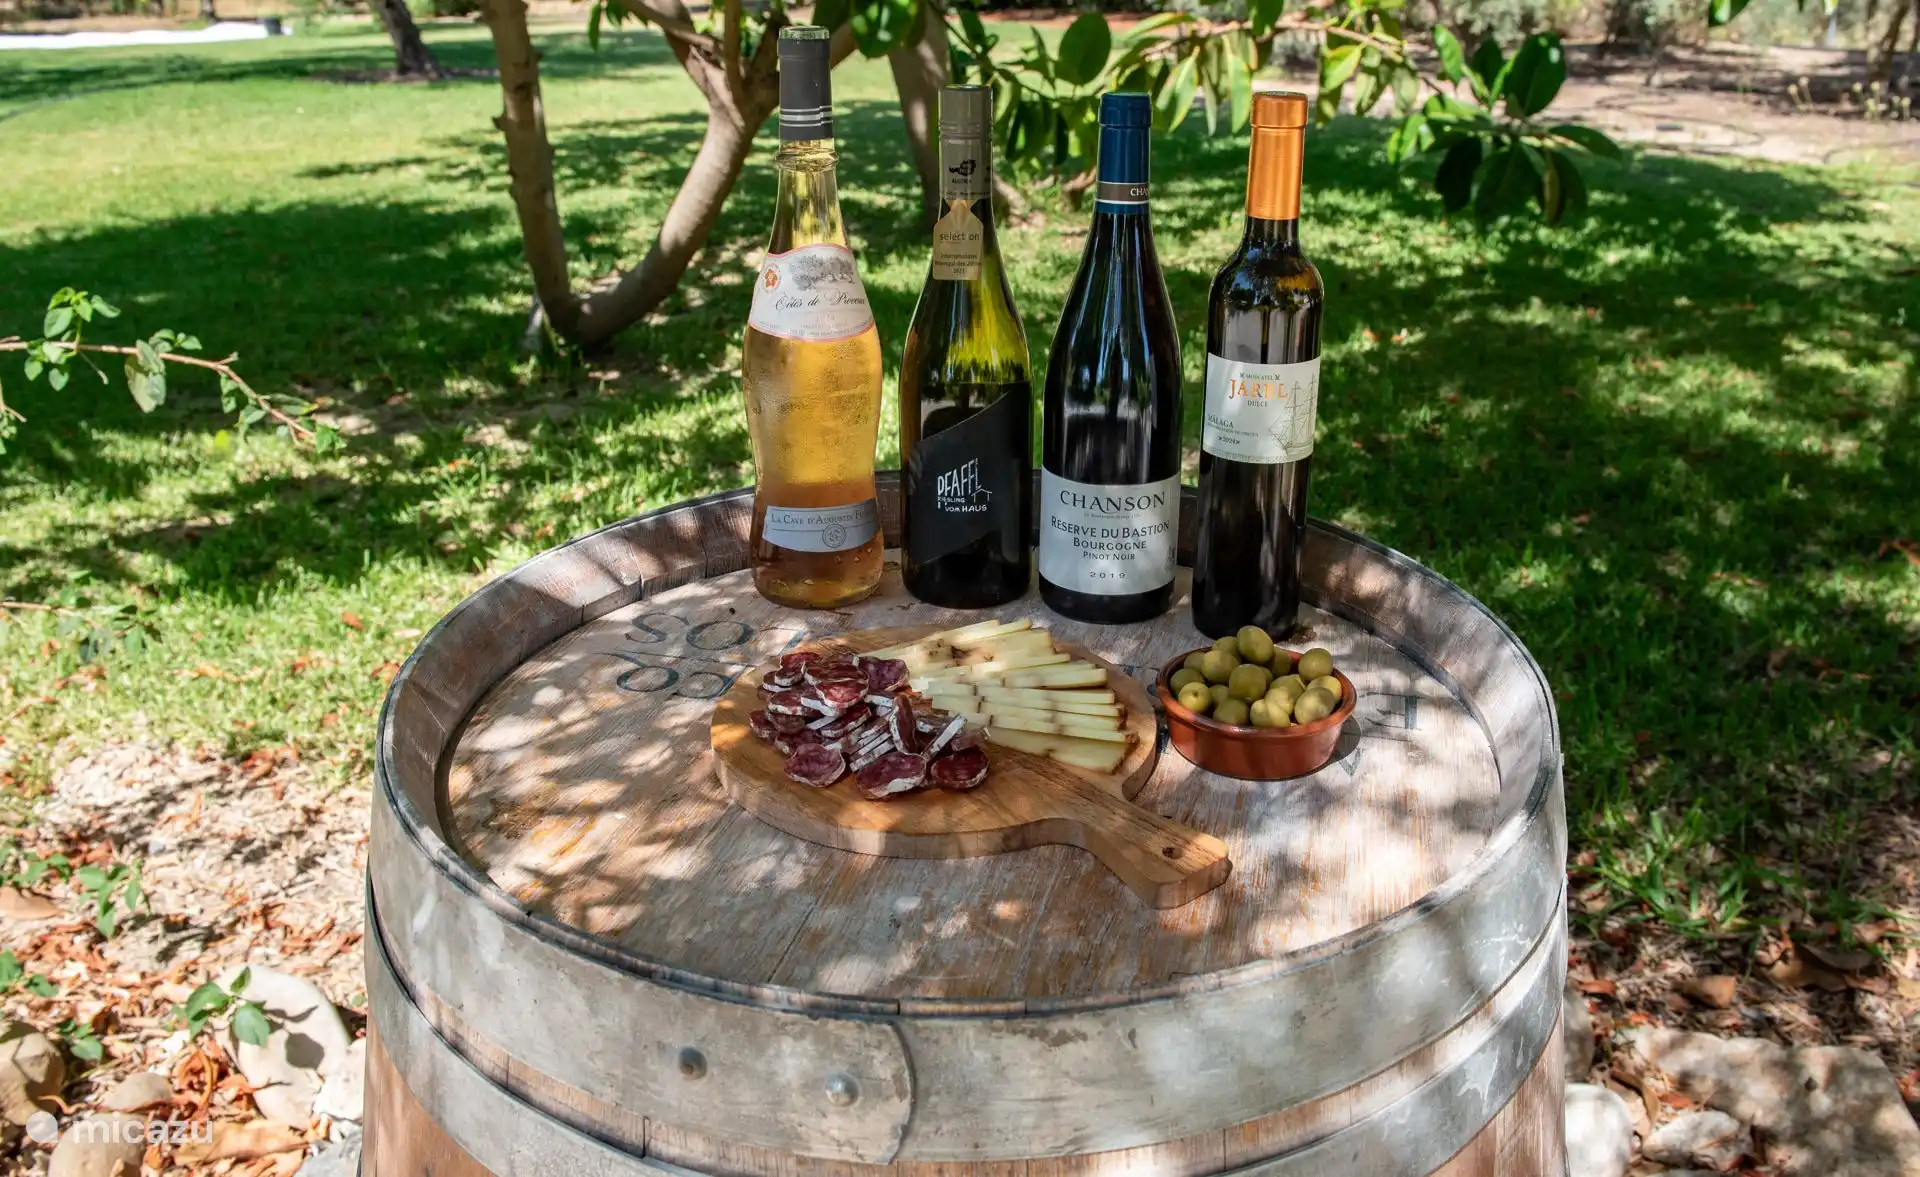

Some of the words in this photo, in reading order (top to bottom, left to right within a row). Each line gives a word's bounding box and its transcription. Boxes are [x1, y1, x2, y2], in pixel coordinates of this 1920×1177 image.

[962, 504, 987, 512] HAUS
[1060, 490, 1165, 514] CHANSON
[1051, 515, 1097, 538] RESERVE
[1101, 528, 1118, 538] DU
[1122, 520, 1169, 539] BASTION
[1073, 537, 1147, 551] BOURGOGNE
[1083, 551, 1110, 560] PINOT
[1113, 553, 1135, 561] NOIR
